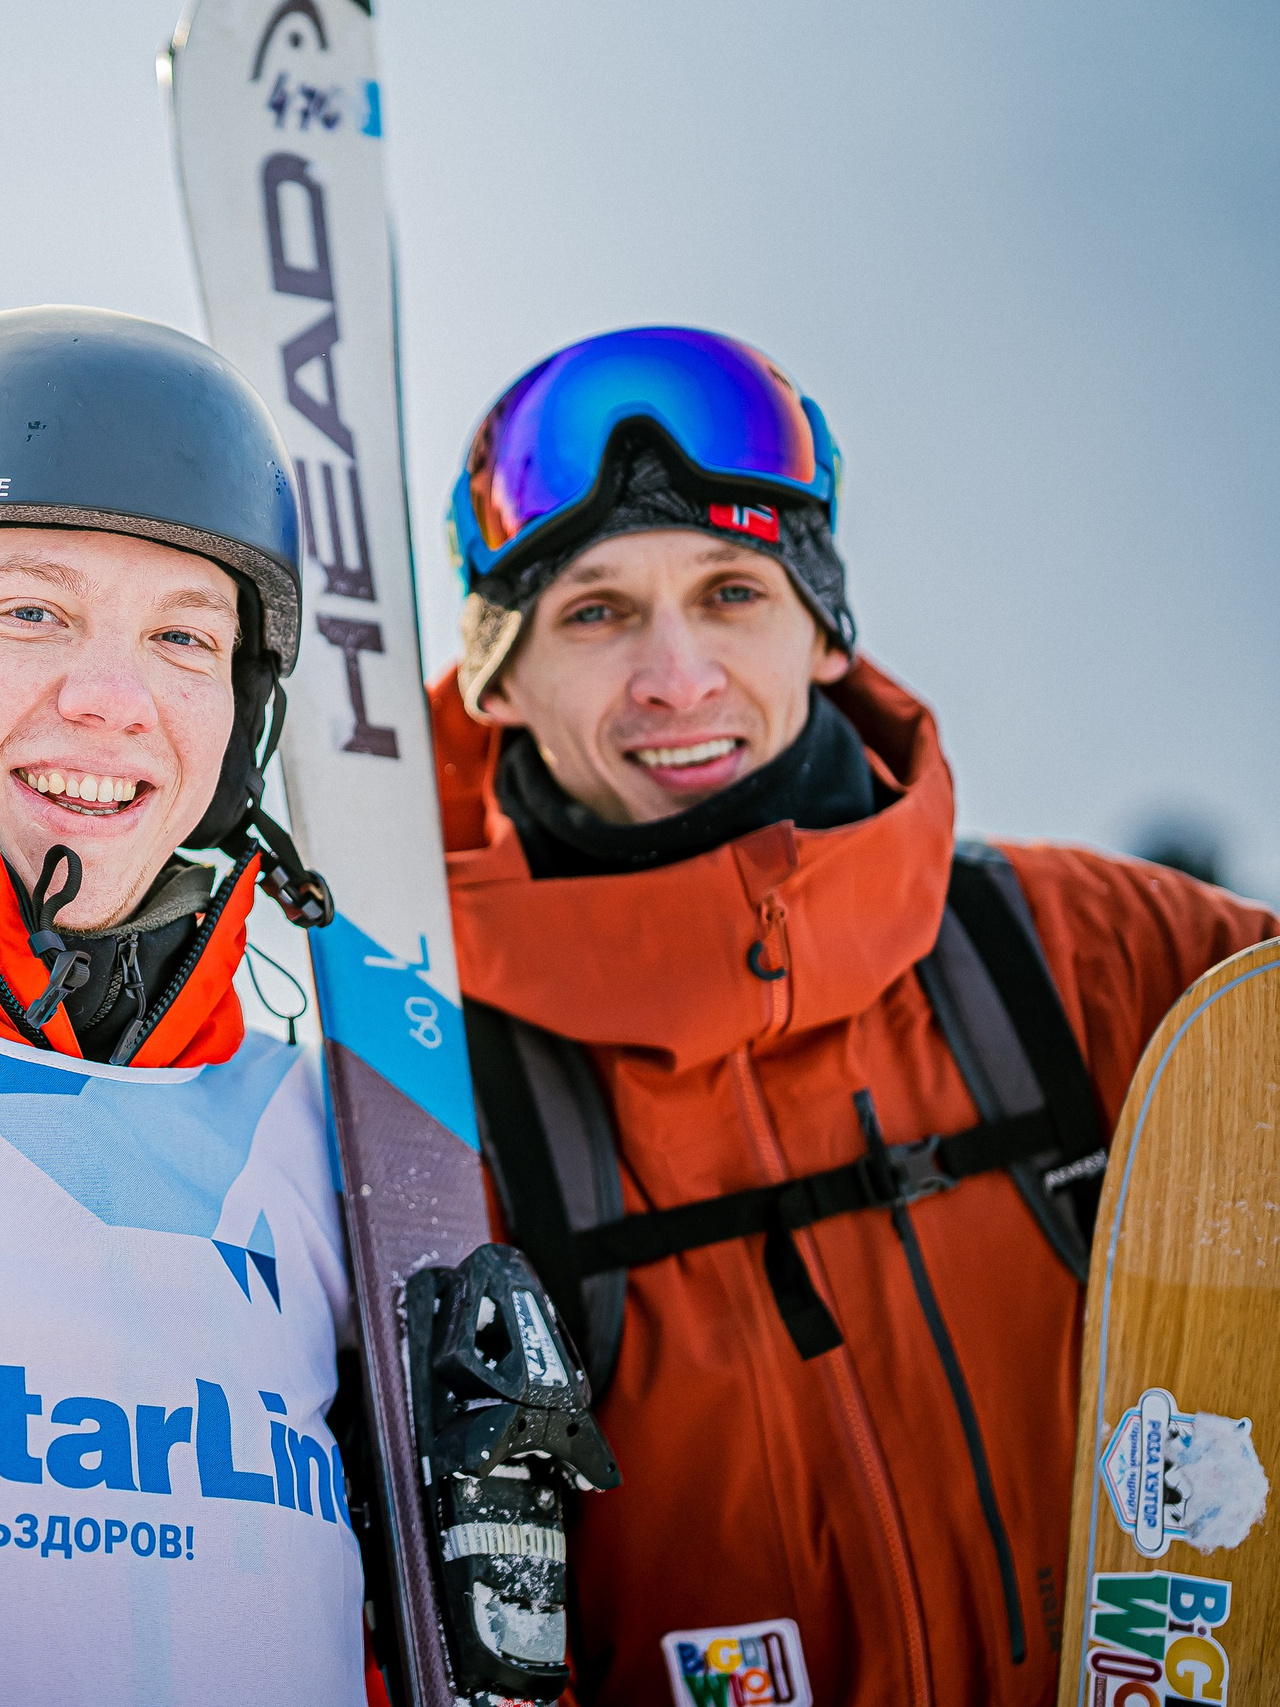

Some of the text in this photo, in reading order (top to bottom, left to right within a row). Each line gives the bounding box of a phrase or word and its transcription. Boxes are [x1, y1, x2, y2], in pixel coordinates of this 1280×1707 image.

[261, 152, 401, 759] HEAD
[1143, 1419, 1163, 1529] РОЗА ХУТОР
